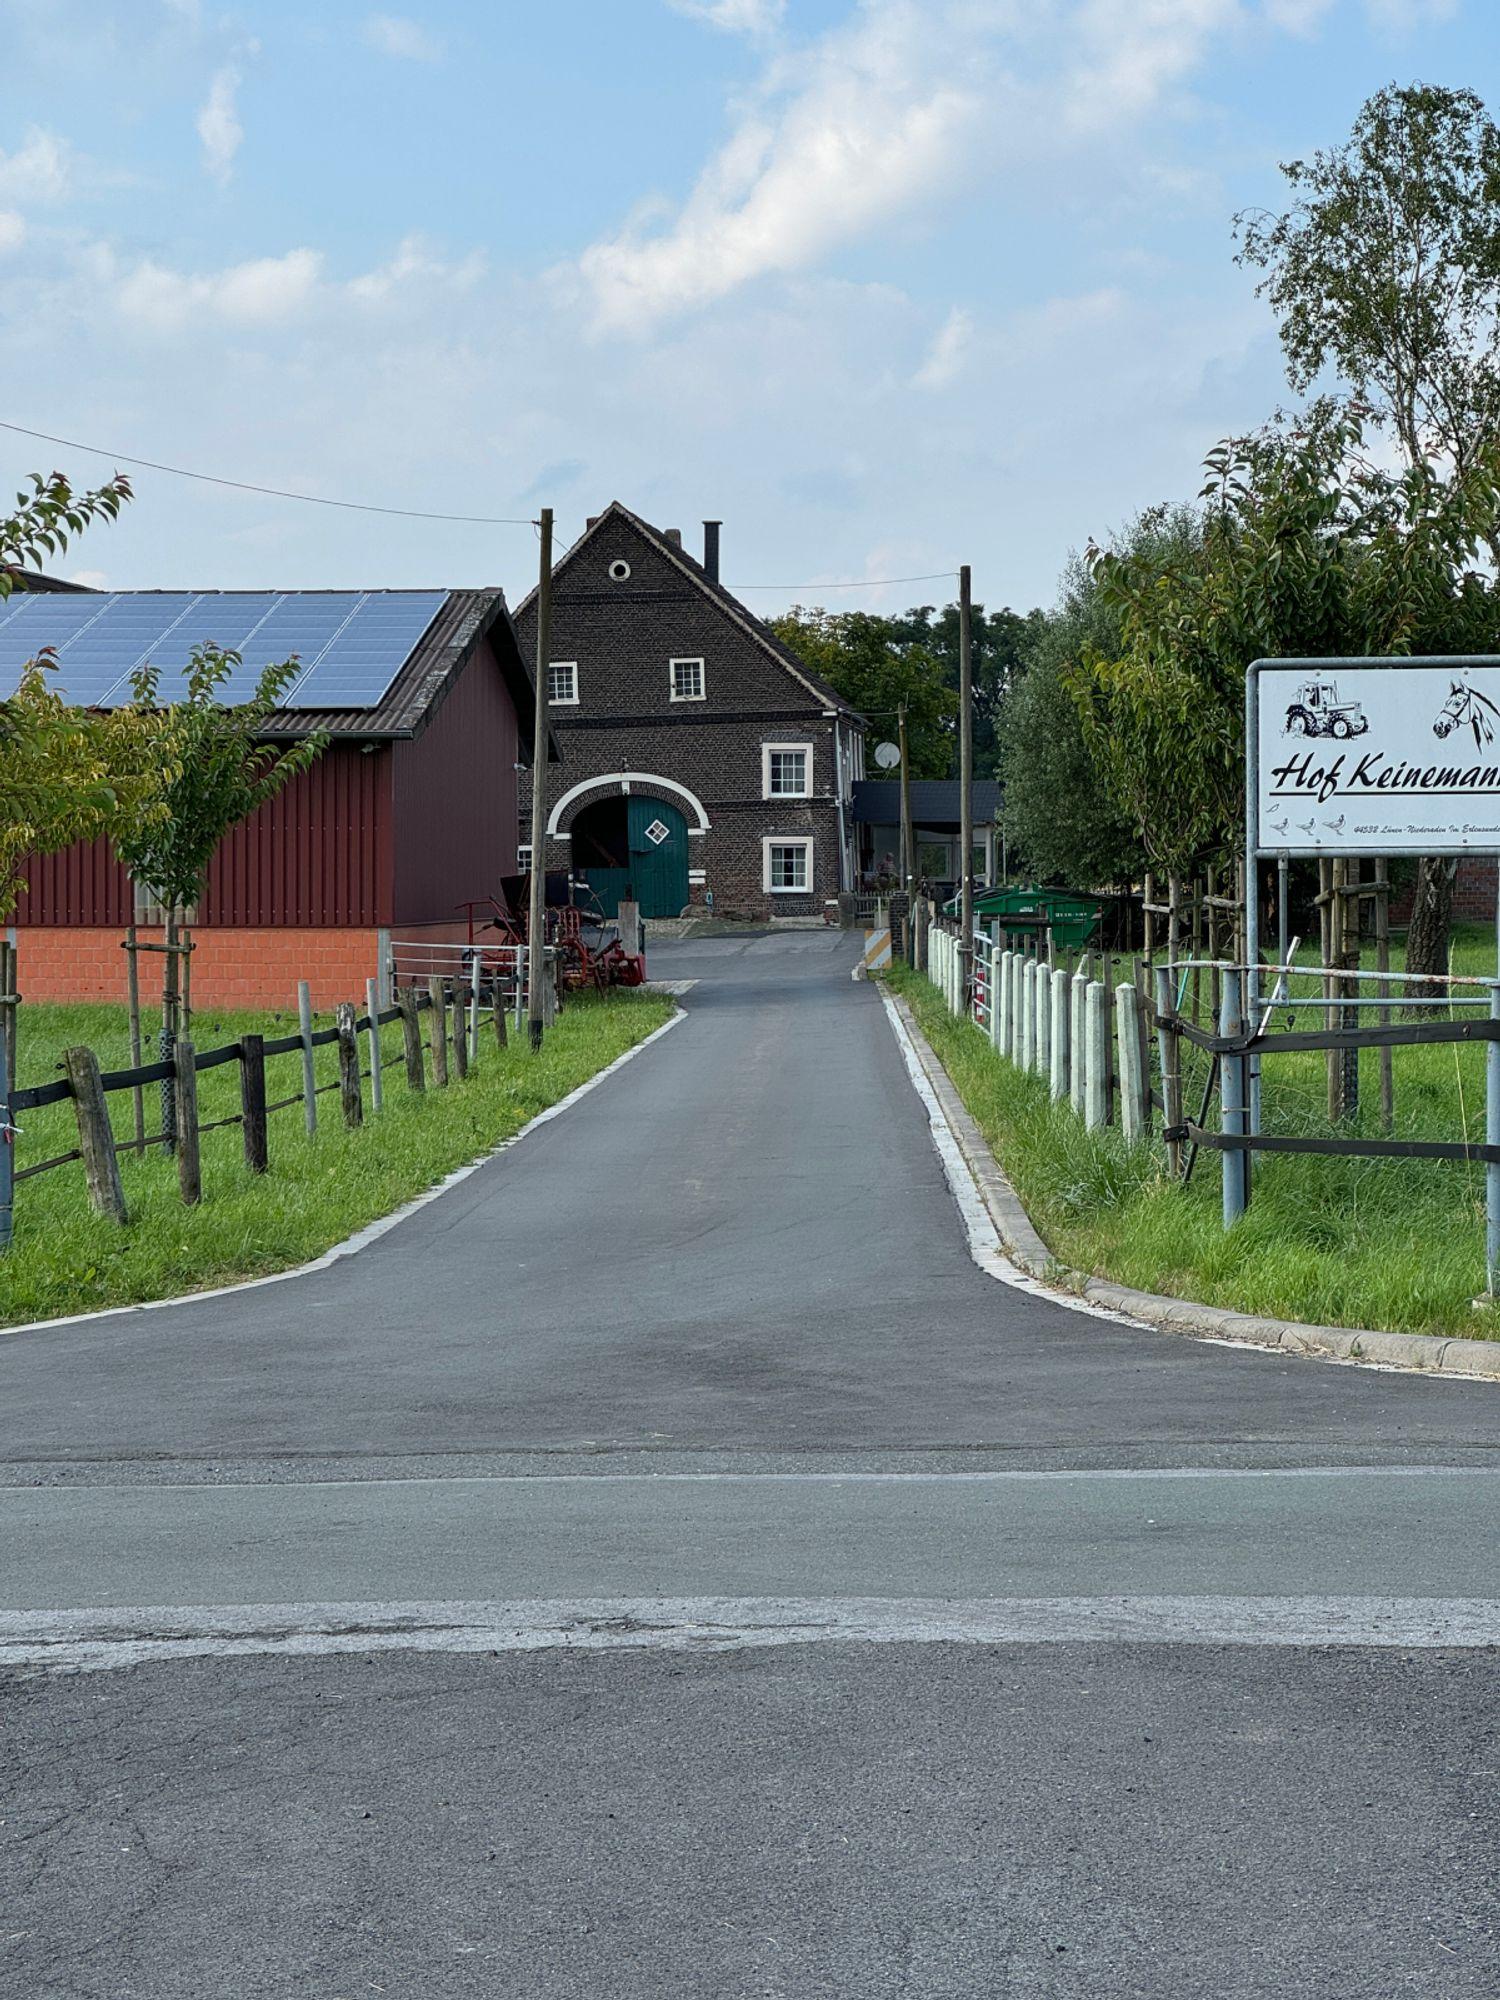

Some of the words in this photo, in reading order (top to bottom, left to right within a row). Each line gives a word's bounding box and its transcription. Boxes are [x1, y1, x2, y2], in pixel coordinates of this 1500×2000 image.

[1271, 752, 1346, 803] Hof
[1347, 752, 1500, 788] Keineman
[1353, 824, 1379, 834] 44532
